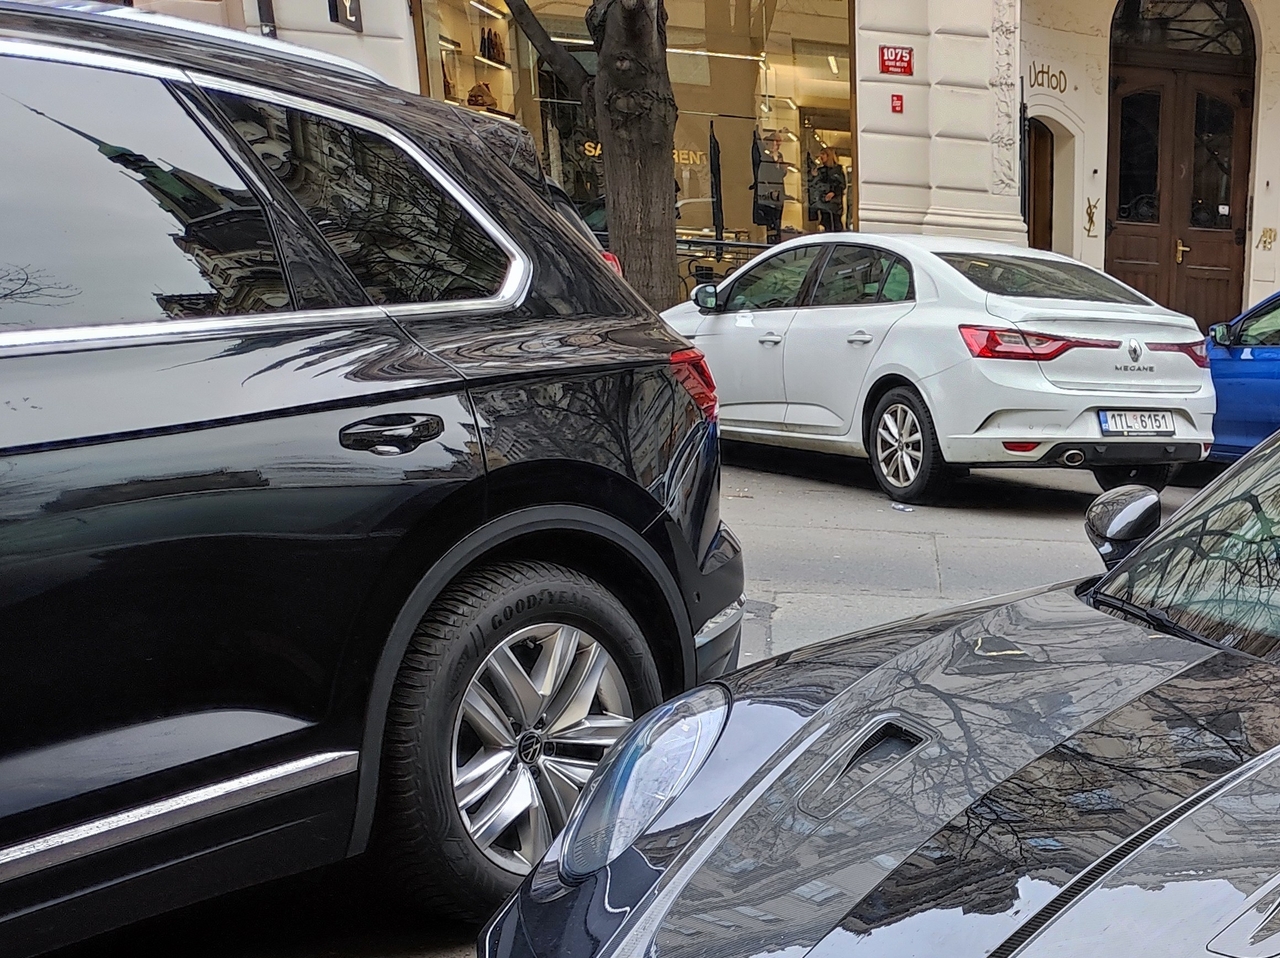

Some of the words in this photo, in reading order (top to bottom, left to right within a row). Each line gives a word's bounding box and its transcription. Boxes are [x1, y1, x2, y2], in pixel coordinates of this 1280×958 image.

[883, 48, 910, 62] 1075
[1111, 413, 1133, 430] 1TL
[1140, 413, 1169, 430] 6151
[491, 588, 592, 630] GOODYEAR
